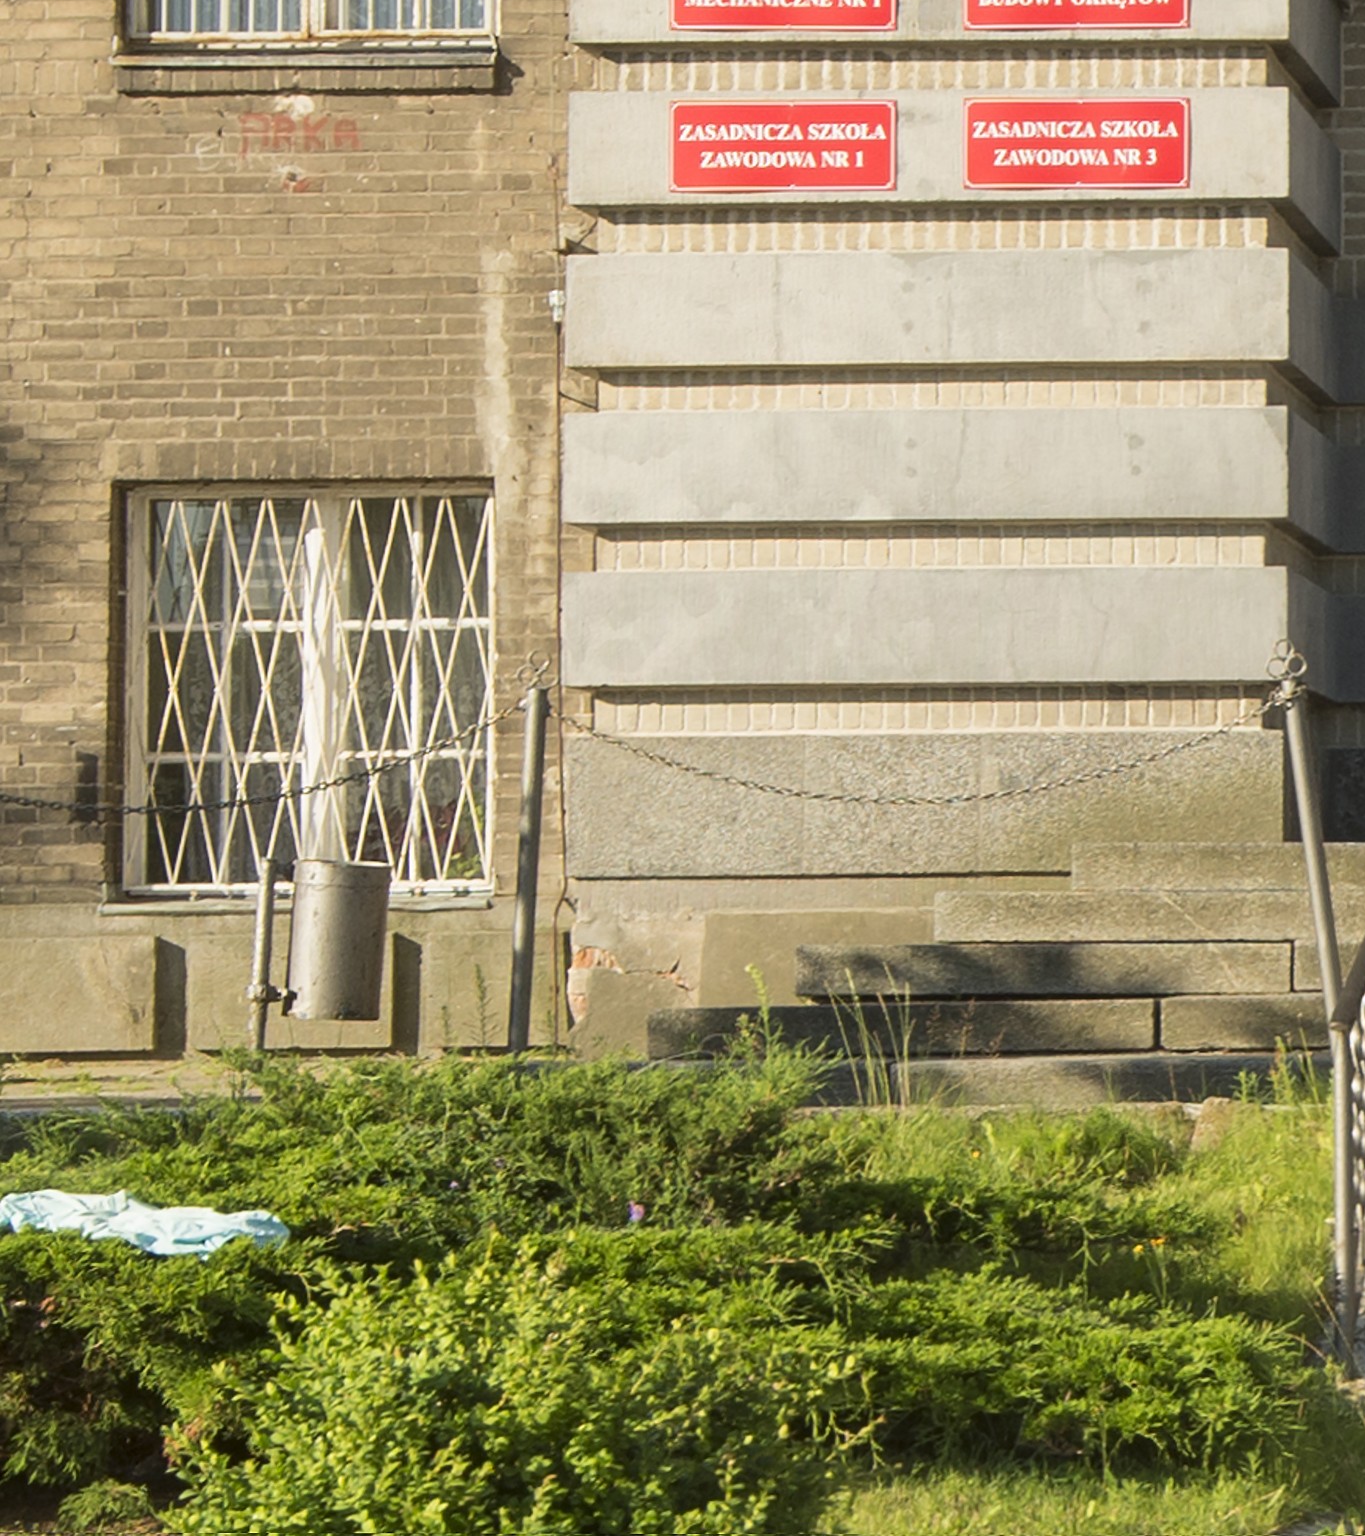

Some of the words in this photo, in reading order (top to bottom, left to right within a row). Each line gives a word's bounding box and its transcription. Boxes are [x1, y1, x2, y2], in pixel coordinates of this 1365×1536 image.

[678, 123, 804, 142] ZASADNICZA
[807, 123, 887, 141] SZKOŁA
[972, 120, 1097, 139] ZASADNICZA
[1099, 120, 1179, 139] SZKOŁA
[700, 151, 817, 169] ZAWODOWA
[821, 150, 850, 168] NR
[855, 150, 864, 168] 1
[993, 148, 1110, 167] ZAWODOWA
[1113, 148, 1142, 166] NR
[1145, 148, 1158, 166] 3
